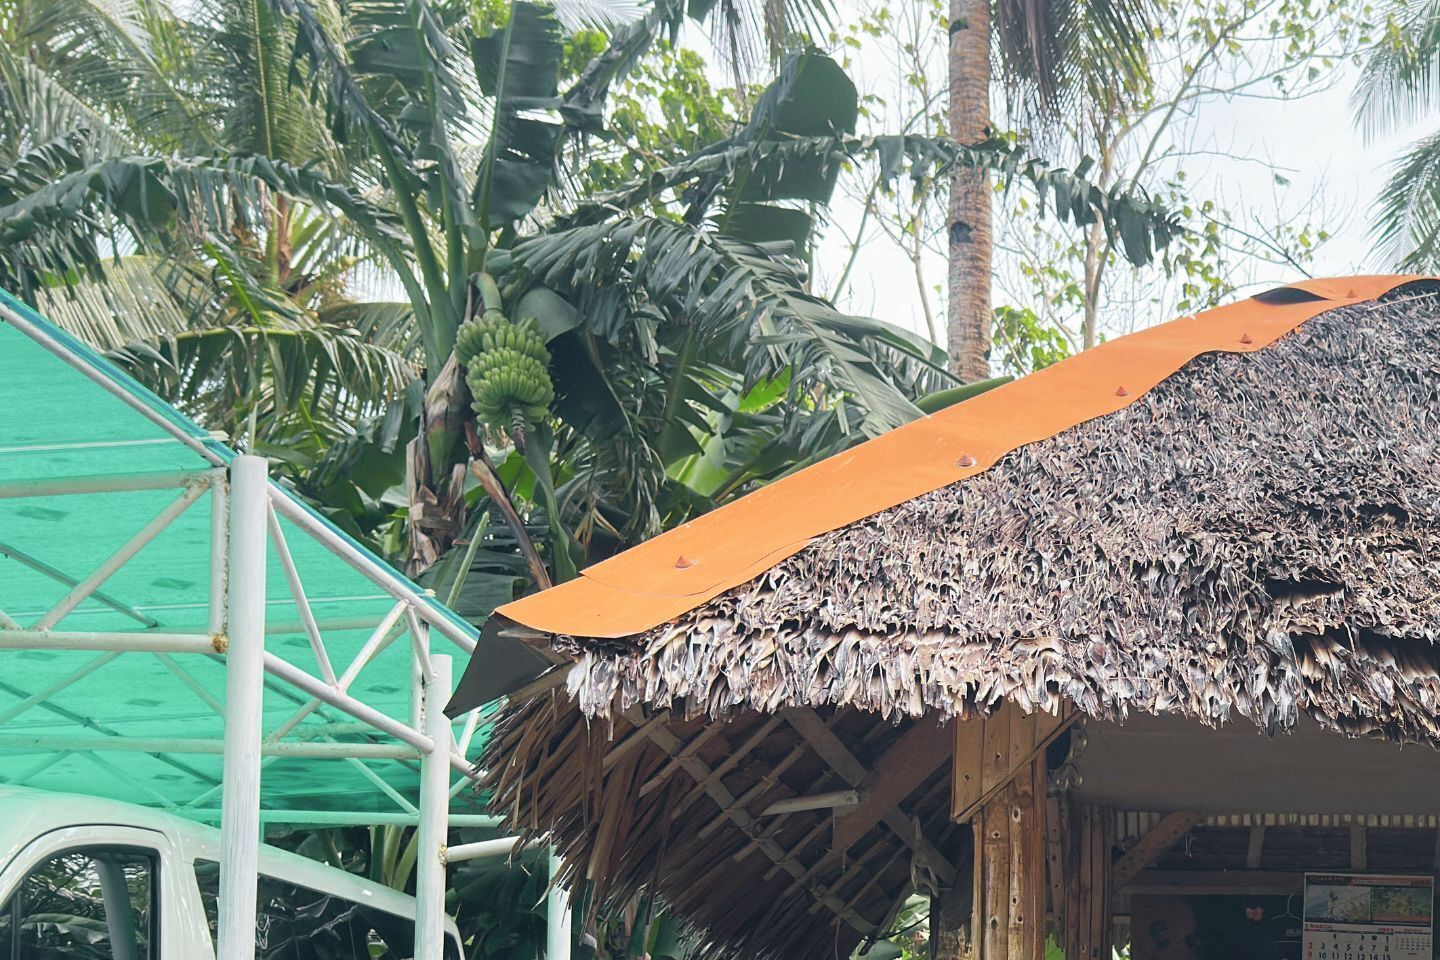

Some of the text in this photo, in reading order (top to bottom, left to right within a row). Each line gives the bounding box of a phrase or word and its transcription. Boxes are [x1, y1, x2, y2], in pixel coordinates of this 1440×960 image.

[1318, 952, 1327, 960] 10
[1332, 952, 1340, 960] 11
[1344, 952, 1353, 960] 12
[1357, 953, 1366, 960] 13
